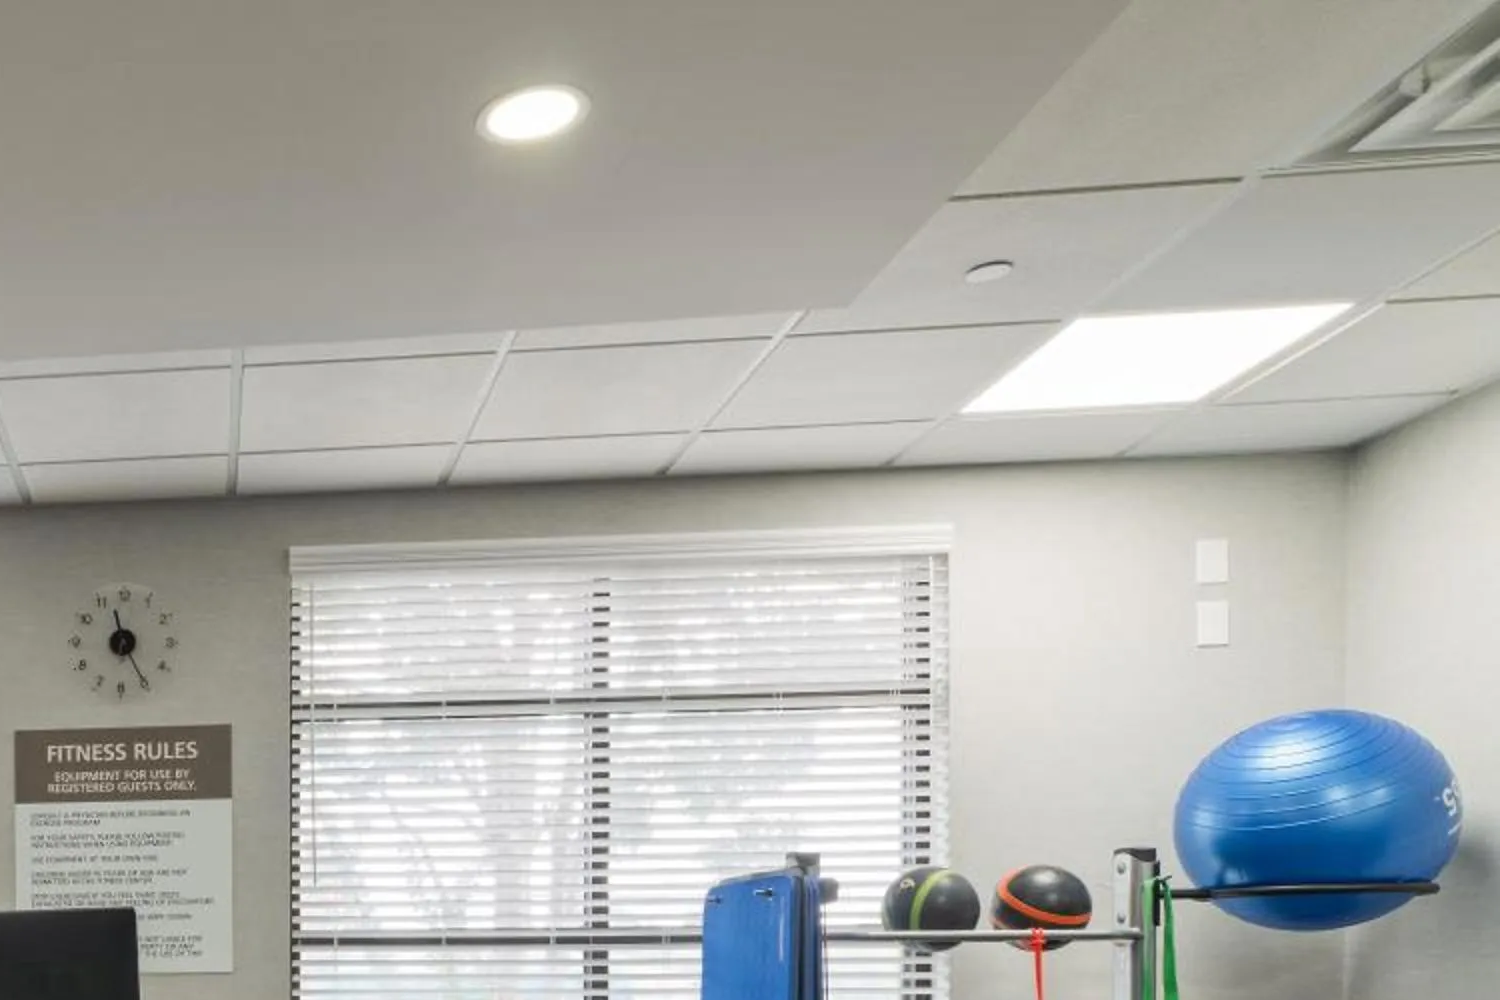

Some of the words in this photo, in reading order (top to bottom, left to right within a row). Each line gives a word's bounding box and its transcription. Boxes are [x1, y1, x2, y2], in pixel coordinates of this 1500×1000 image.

[47, 743, 127, 763] FITNESS
[134, 741, 198, 760] RULES
[54, 771, 120, 783] EQUIPMENT
[125, 770, 147, 780] FOR
[150, 769, 171, 780] USE
[175, 768, 190, 779] BY
[47, 783, 115, 794] REGISTERED
[117, 781, 161, 792] GUESTS
[164, 780, 197, 791] ONLY.
